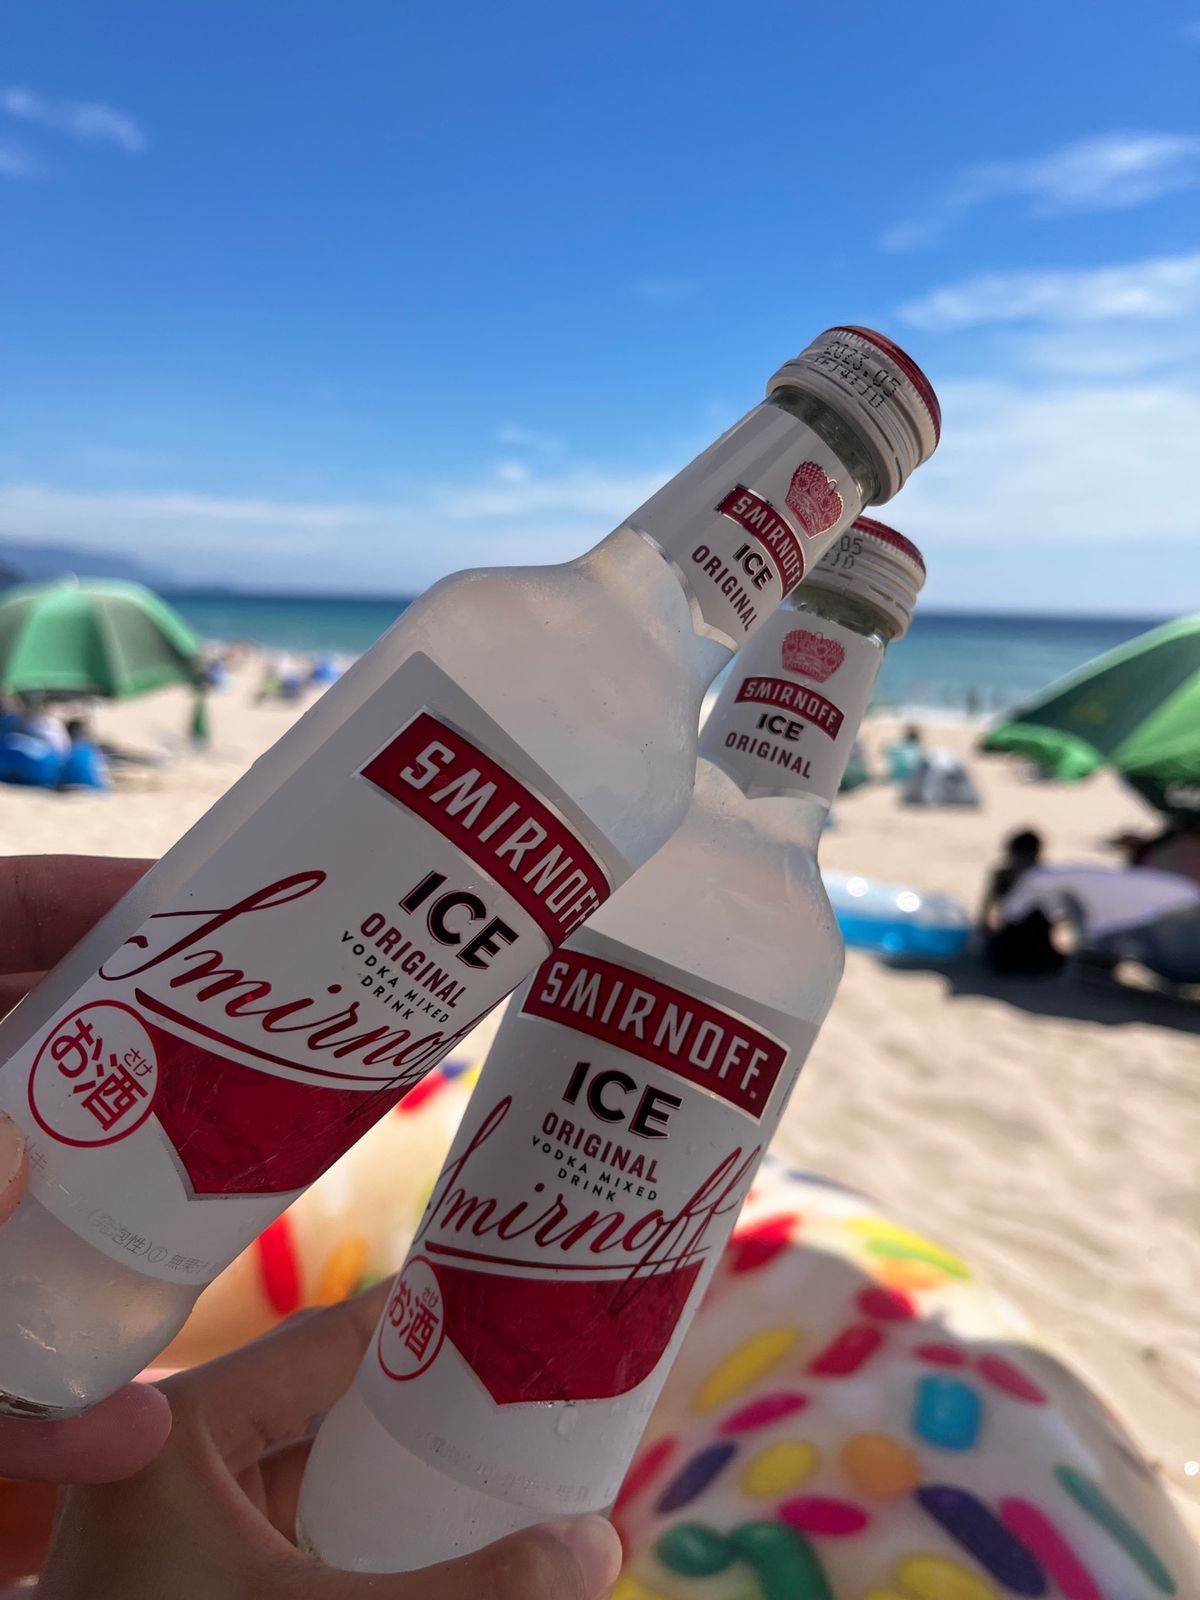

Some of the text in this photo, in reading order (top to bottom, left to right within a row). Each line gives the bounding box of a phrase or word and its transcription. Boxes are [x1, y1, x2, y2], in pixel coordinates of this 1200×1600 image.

[823, 340, 902, 398] 2023.05
[690, 544, 758, 632] ORIGINAL
[732, 542, 774, 592] ICE
[725, 731, 812, 779] ORIGINAL
[755, 713, 804, 742] ICE
[398, 870, 519, 970] ICE
[340, 930, 450, 1024] VODKA MIXED
[360, 912, 467, 1009] ORIGINAL
[360, 974, 415, 1021] DRINK
[123, 1047, 153, 1077] さけ
[540, 960, 769, 1100] SMIRNOFF.
[50, 1018, 149, 1132] お酒
[561, 1061, 683, 1140] ICE
[531, 1135, 658, 1202] VODKA MIXED
[542, 1111, 658, 1184] ORIGINAL
[557, 1167, 617, 1203] DRINK
[413, 1095, 762, 1318] Smirnoff
[387, 1280, 440, 1362] お酒
